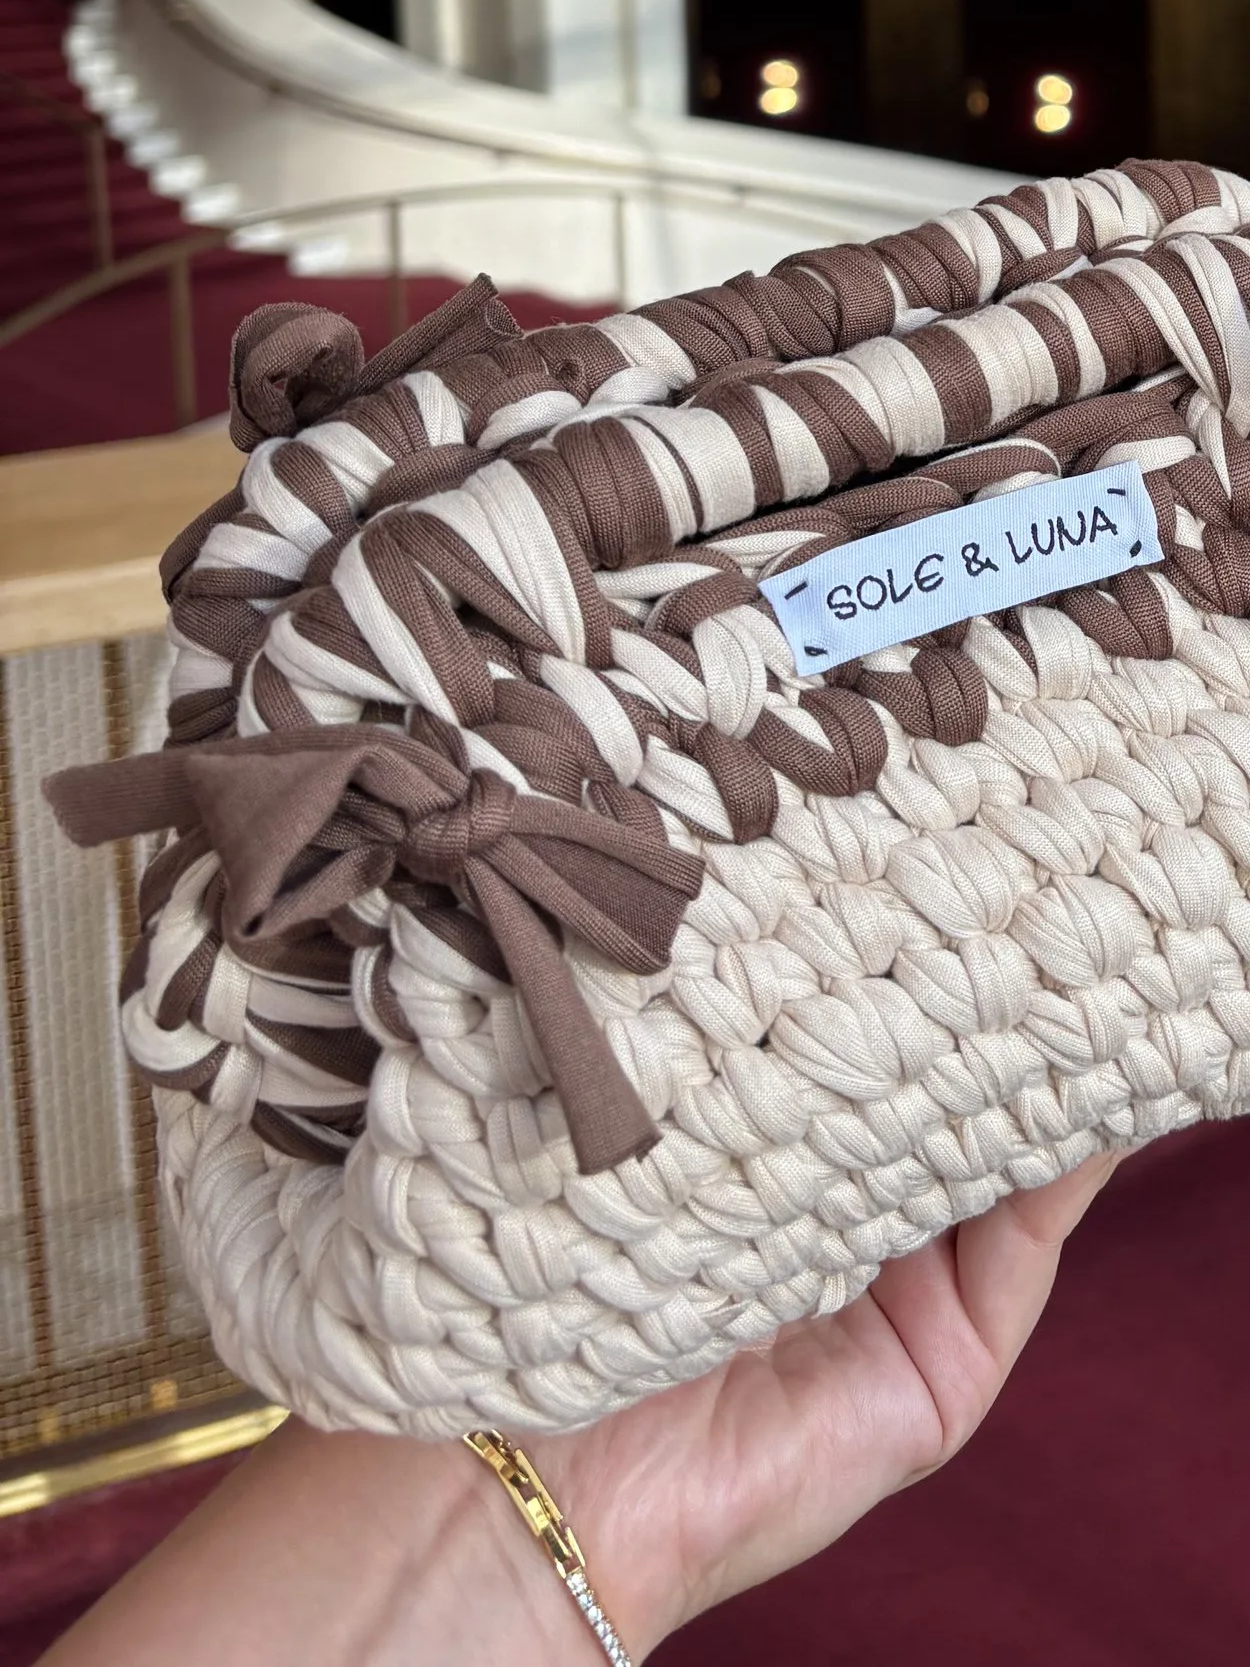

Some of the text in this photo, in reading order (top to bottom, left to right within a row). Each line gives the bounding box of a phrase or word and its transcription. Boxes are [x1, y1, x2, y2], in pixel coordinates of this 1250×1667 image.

[826, 505, 1119, 621] SOLE & LUNA
